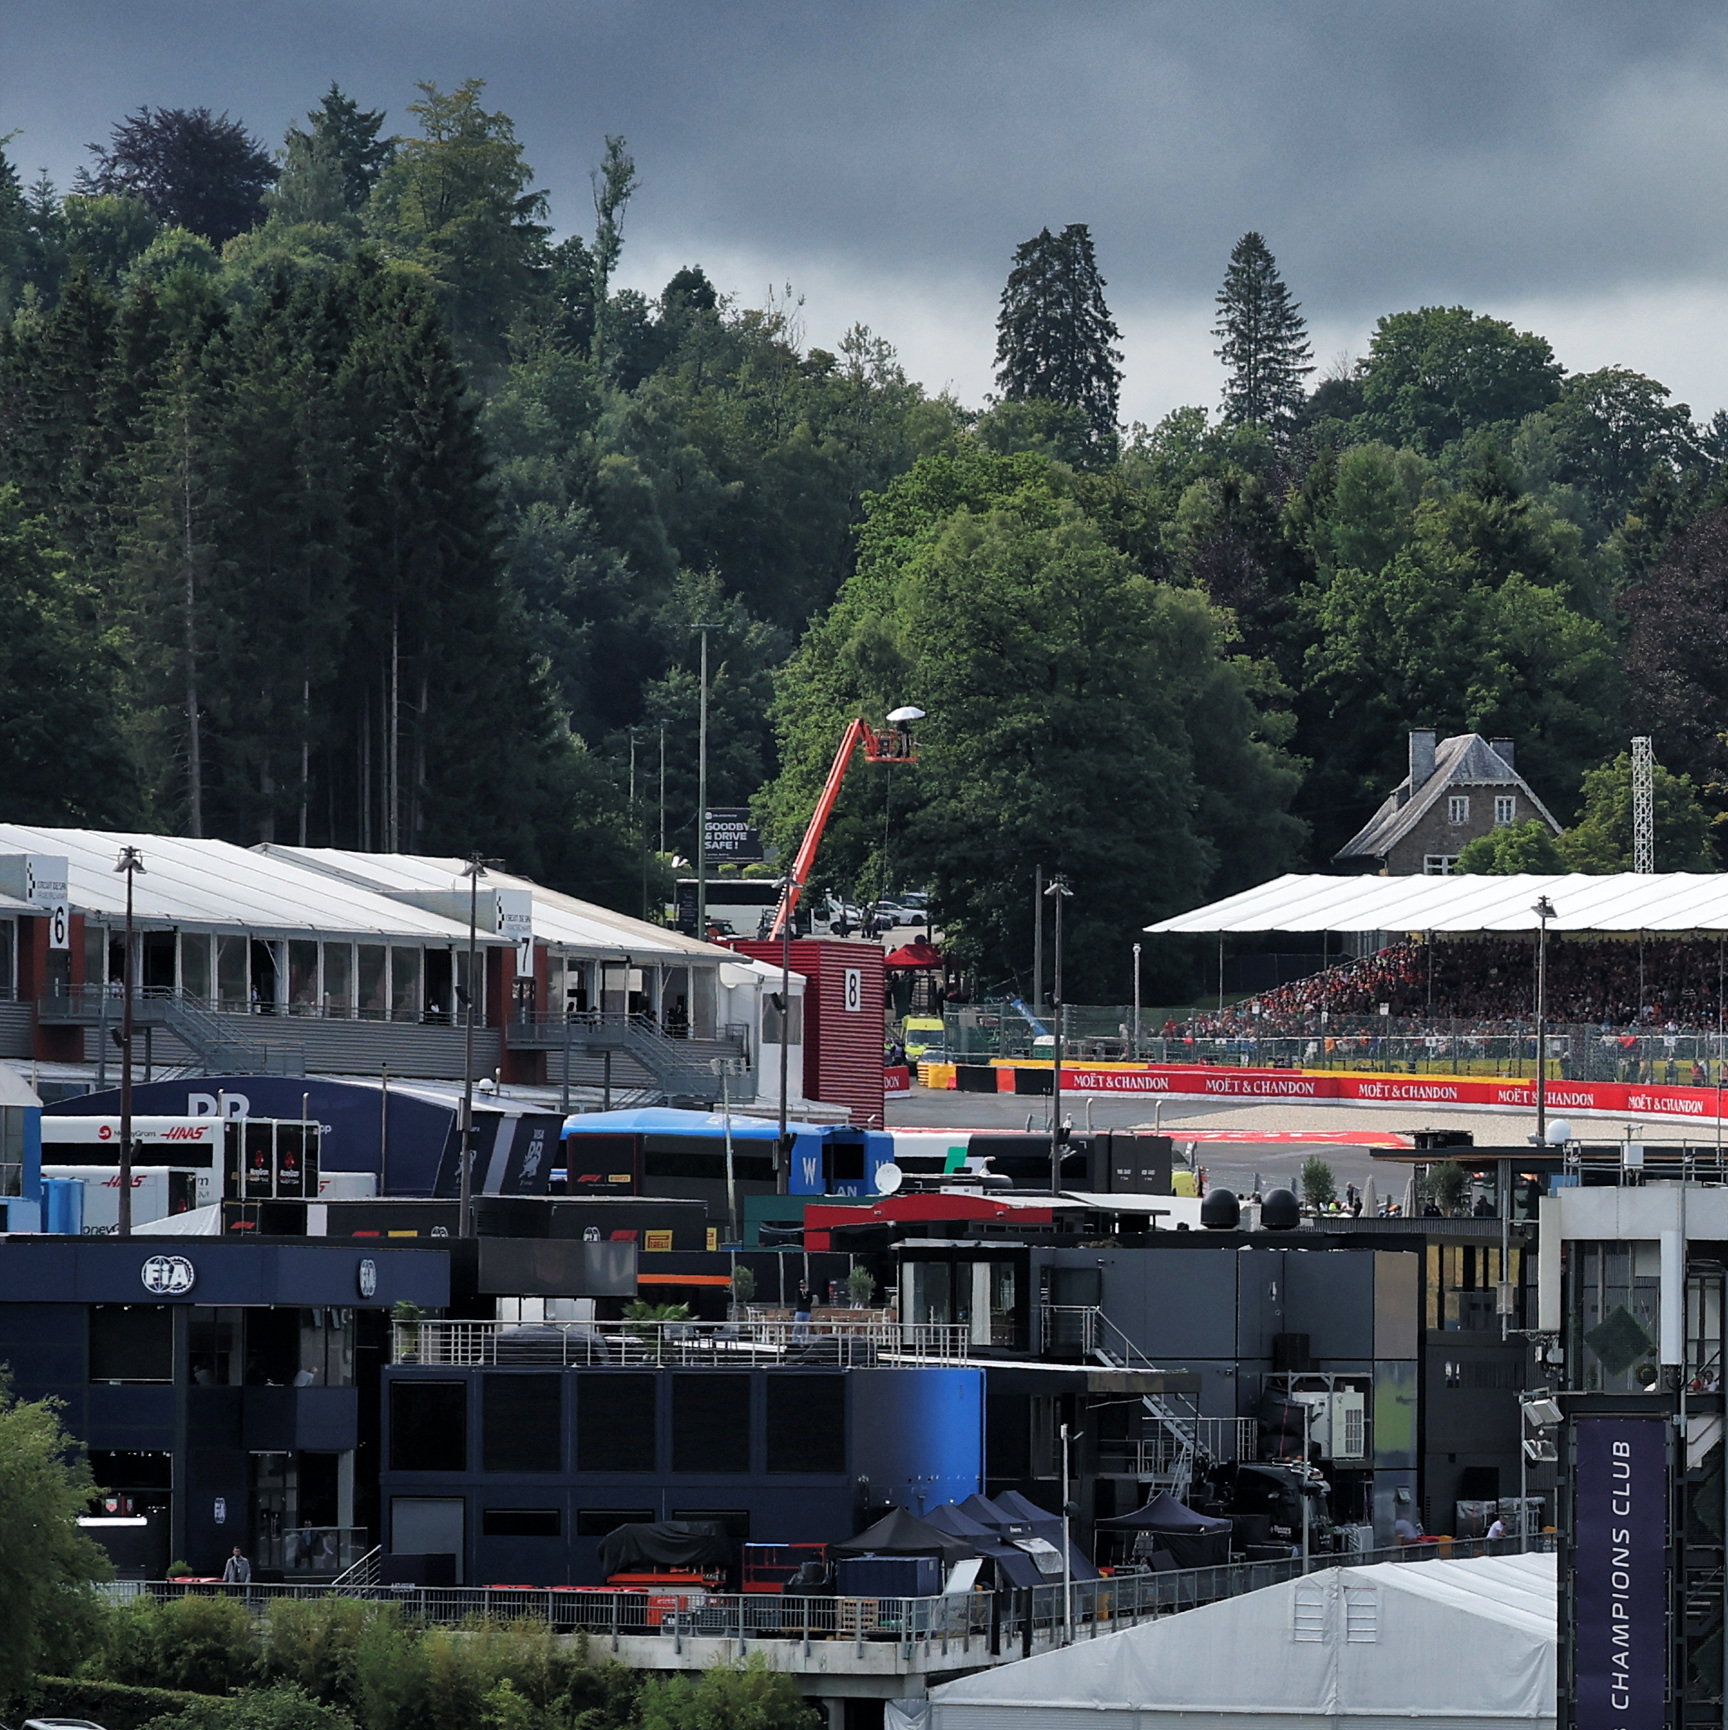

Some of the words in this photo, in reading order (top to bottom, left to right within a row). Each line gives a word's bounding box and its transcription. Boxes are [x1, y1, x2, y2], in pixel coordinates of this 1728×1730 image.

[714, 832, 748, 840] DRIVE
[704, 841, 733, 850] SAFE
[54, 906, 65, 944] 6
[521, 938, 531, 972] 7
[848, 974, 858, 1007] 8
[1073, 1074, 1104, 1087] MOËT
[1106, 1077, 1114, 1089] &
[1114, 1077, 1169, 1089] CHANDON
[1205, 1079, 1241, 1093] MOËT
[1242, 1081, 1252, 1094] &
[1253, 1082, 1315, 1094] CHANDON
[1358, 1083, 1391, 1096] MOËT
[1391, 1086, 1400, 1098] &
[1401, 1086, 1458, 1099] CHANDON
[1661, 1098, 1704, 1113] CHANDON
[160, 1126, 208, 1139] HAAS
[1612, 1440, 1630, 1516] CLUB
[1612, 1525, 1630, 1710] CHAMPIONS
